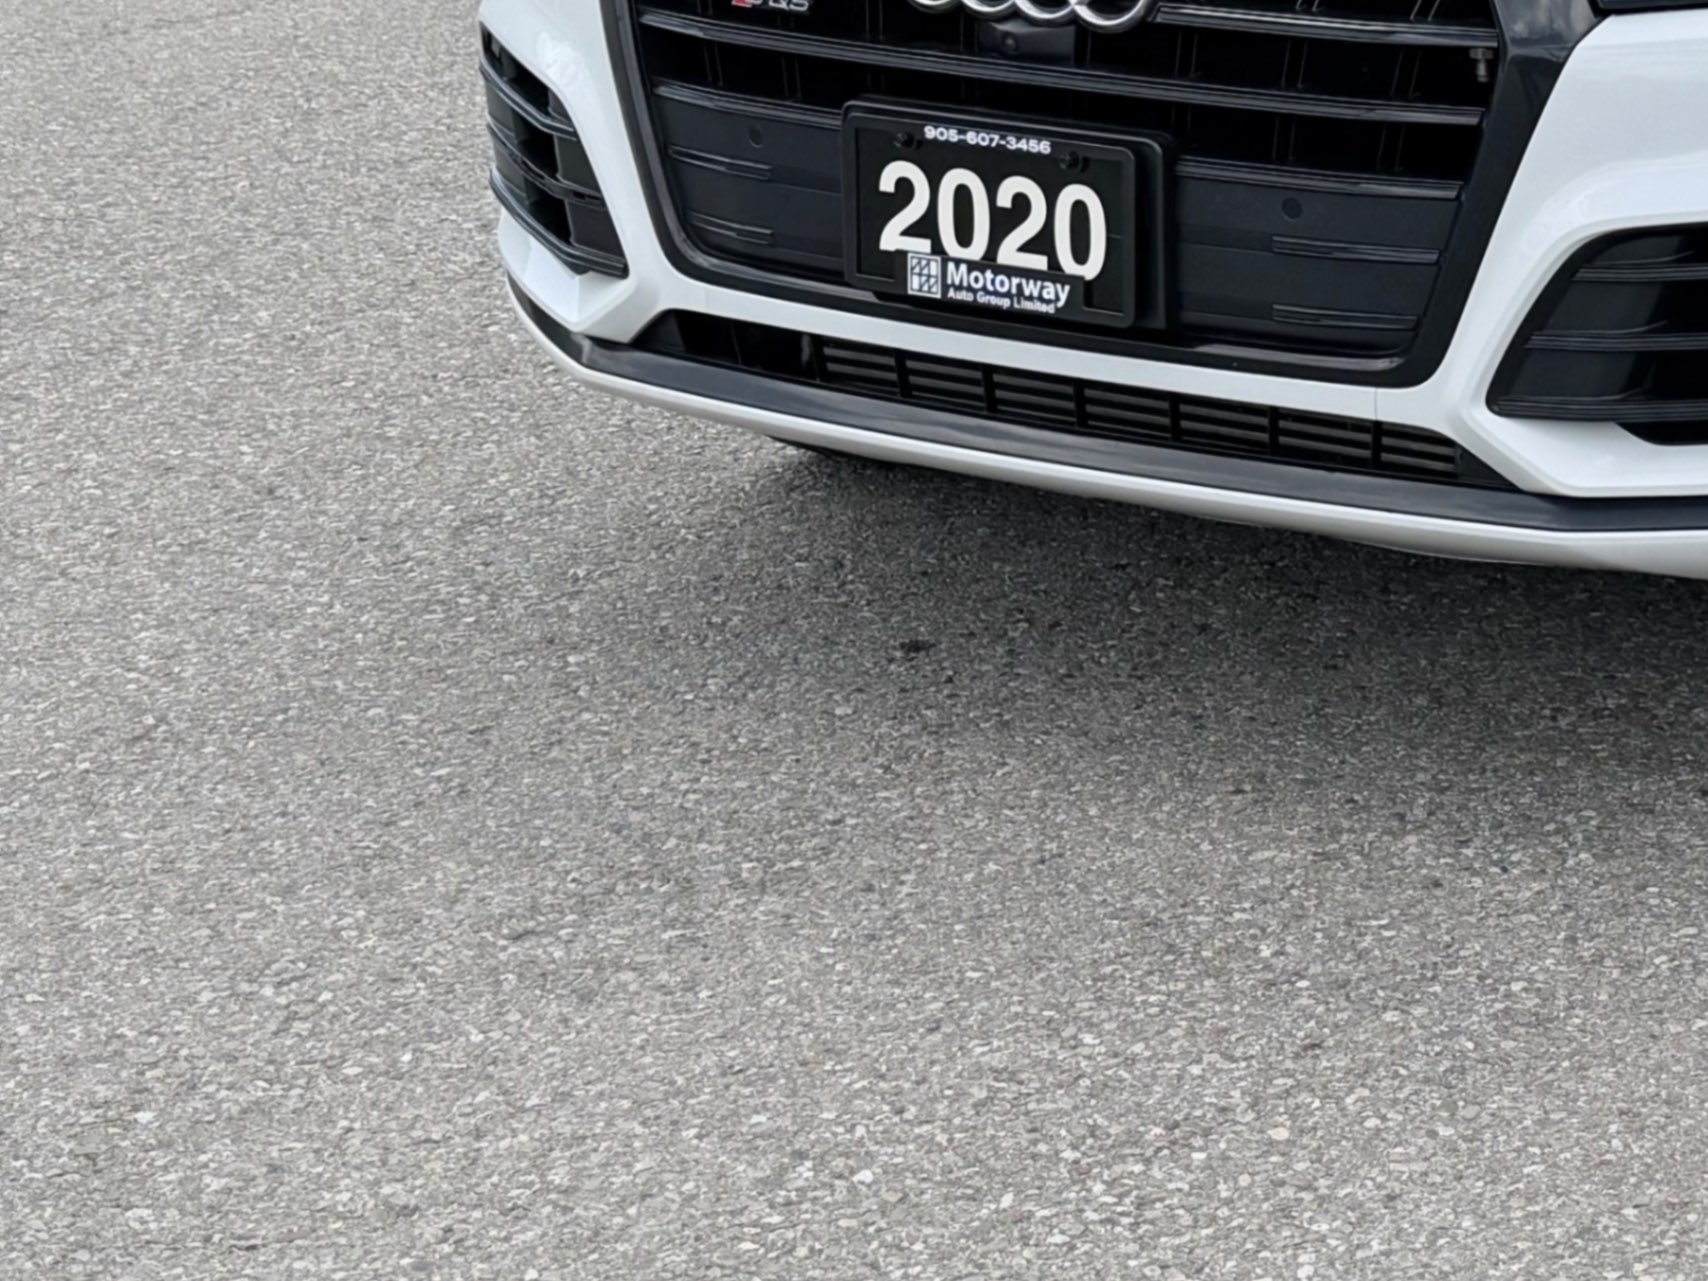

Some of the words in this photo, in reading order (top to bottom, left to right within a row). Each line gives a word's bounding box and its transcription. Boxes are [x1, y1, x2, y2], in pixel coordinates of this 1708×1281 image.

[923, 125, 1052, 155] 905-607-3456
[878, 160, 1108, 282] 2020
[946, 261, 1071, 309] Motorway
[947, 287, 975, 302] Auto
[976, 290, 1012, 310] Group
[1013, 296, 1056, 314] Limited
